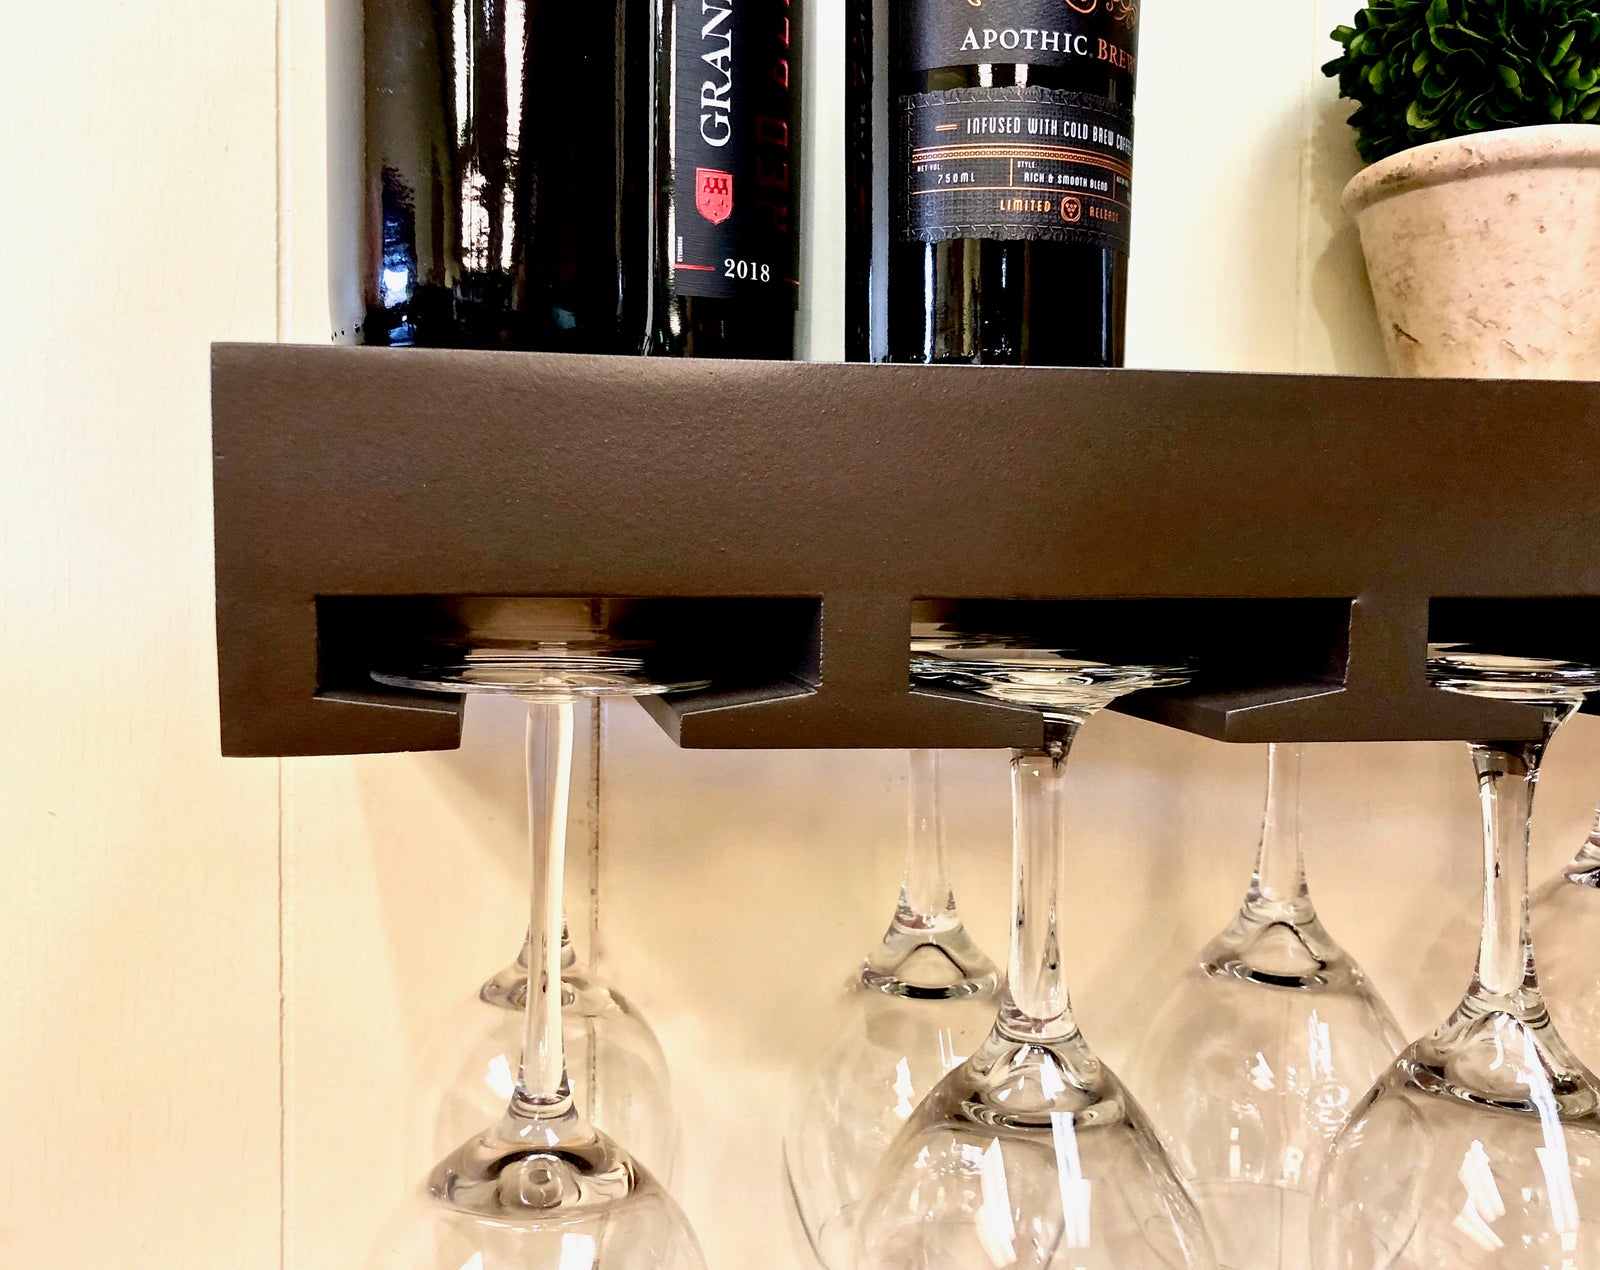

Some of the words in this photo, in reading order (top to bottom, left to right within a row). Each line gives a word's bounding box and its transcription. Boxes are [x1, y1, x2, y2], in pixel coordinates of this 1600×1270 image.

[960, 28, 1088, 56] APOTHIC
[700, 0, 734, 147] GRAN
[967, 117, 1021, 134] INFUSED
[1027, 117, 1058, 136] WITH
[1063, 121, 1089, 140] COLD
[1092, 125, 1115, 147] BREW
[937, 172, 976, 184] 750ML
[1023, 172, 1045, 183] RICH
[1048, 173, 1055, 184] &
[1057, 174, 1088, 187] SMOOTH
[1089, 178, 1109, 192] BLEND
[1000, 198, 1052, 212] LIMITED
[723, 258, 771, 283] 2018
